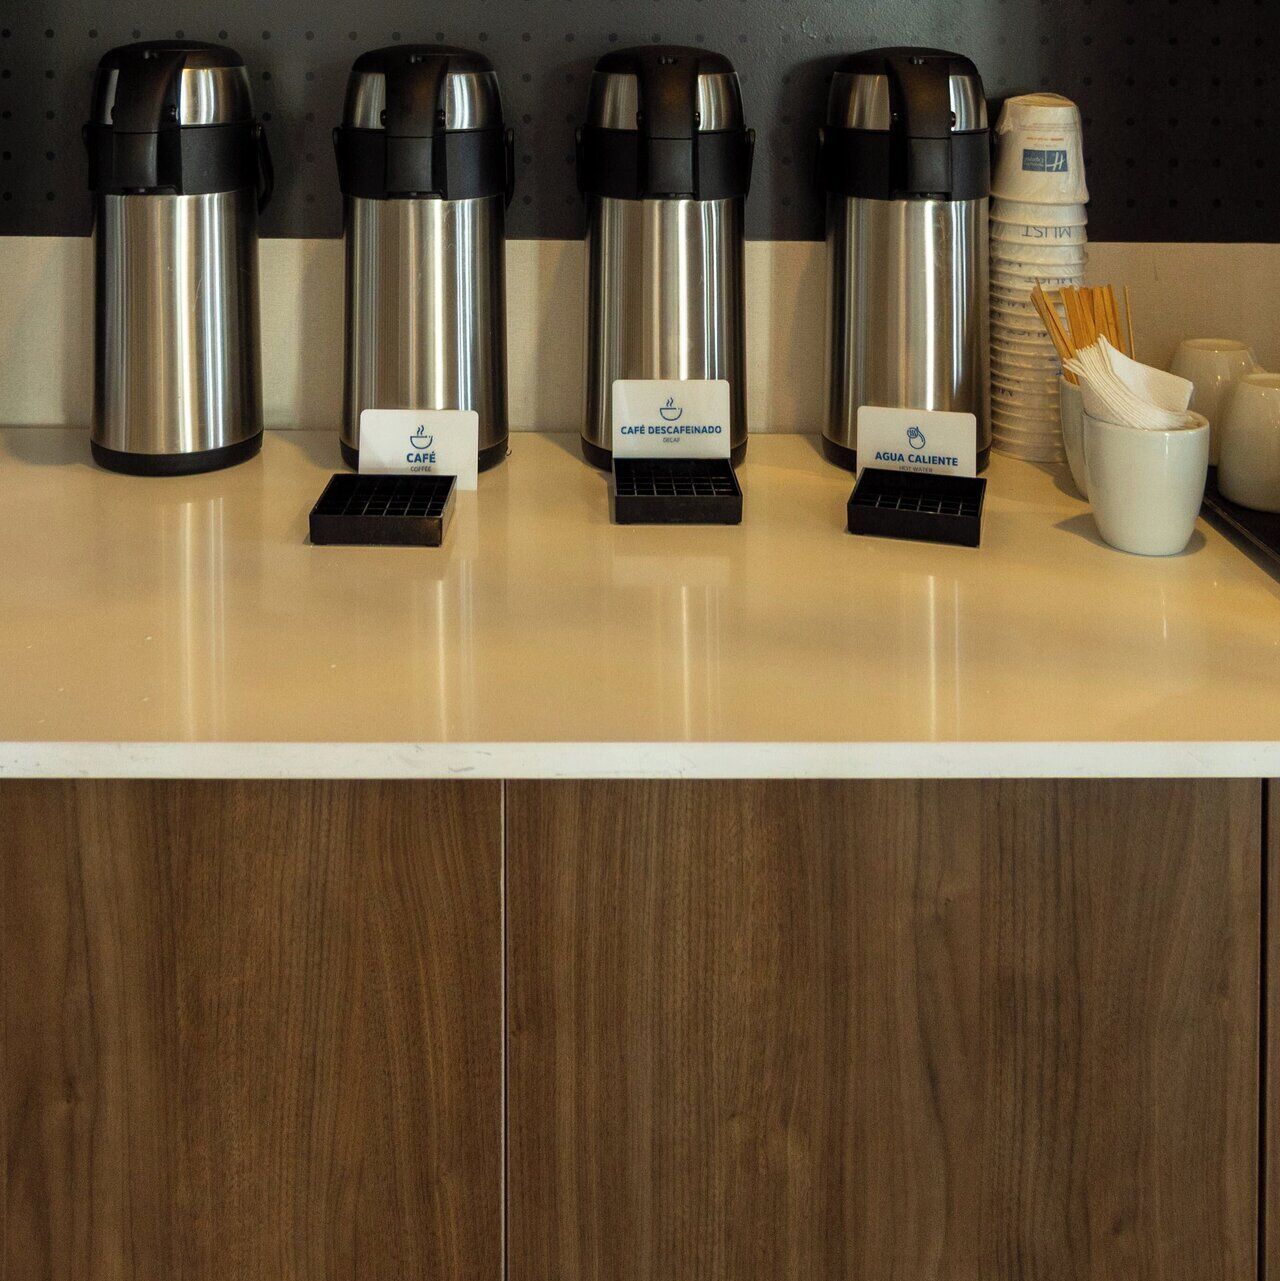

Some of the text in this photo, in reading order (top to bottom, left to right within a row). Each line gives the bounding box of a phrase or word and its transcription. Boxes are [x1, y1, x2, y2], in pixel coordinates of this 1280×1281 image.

[621, 424, 645, 434] CAFÉ
[406, 451, 436, 463] CAFÉ
[875, 451, 959, 466] AGUA CALIENTE
